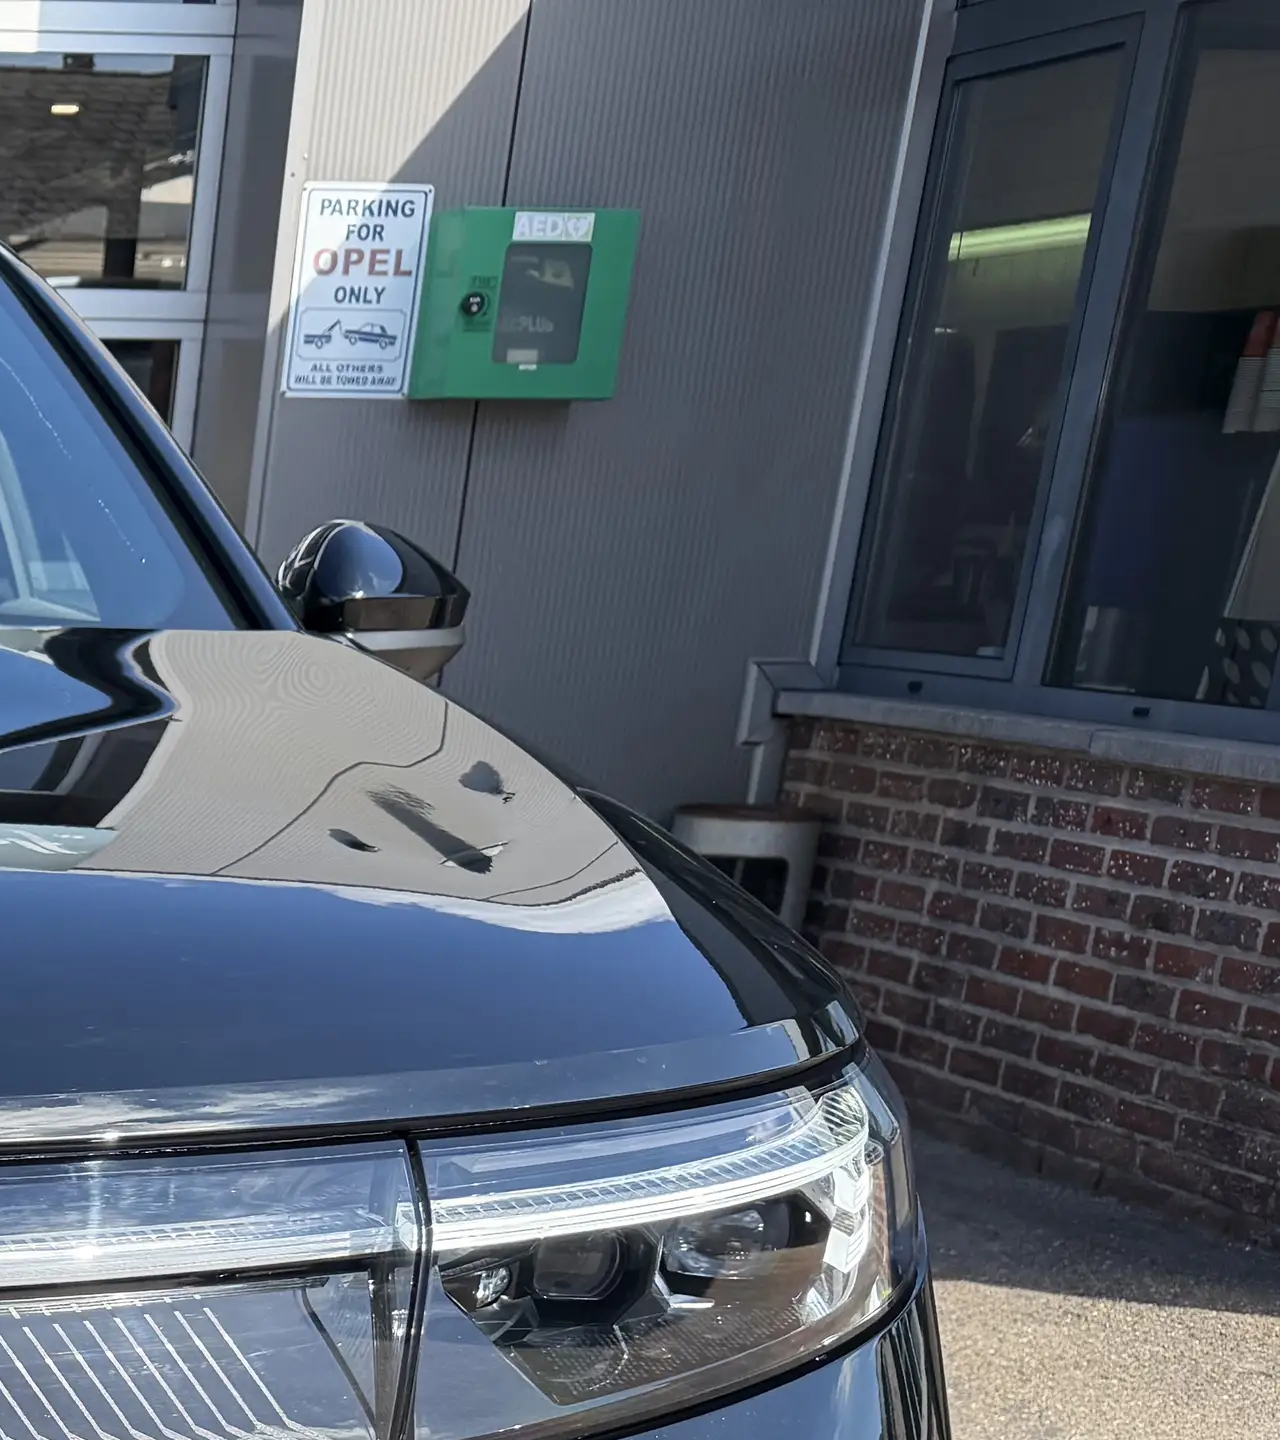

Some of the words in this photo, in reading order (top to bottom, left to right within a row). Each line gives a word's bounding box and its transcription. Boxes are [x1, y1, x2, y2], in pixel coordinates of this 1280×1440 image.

[319, 198, 416, 218] PARKING
[345, 223, 385, 242] FOR
[515, 215, 563, 236] AED
[313, 248, 413, 277] OPEL
[334, 286, 386, 304] ONLY
[309, 363, 332, 373] ALL
[336, 363, 384, 374] OTHERS
[294, 374, 316, 385] WILL
[320, 375, 332, 386] BE
[336, 375, 369, 387] TOWED
[370, 376, 396, 387] AWAY
